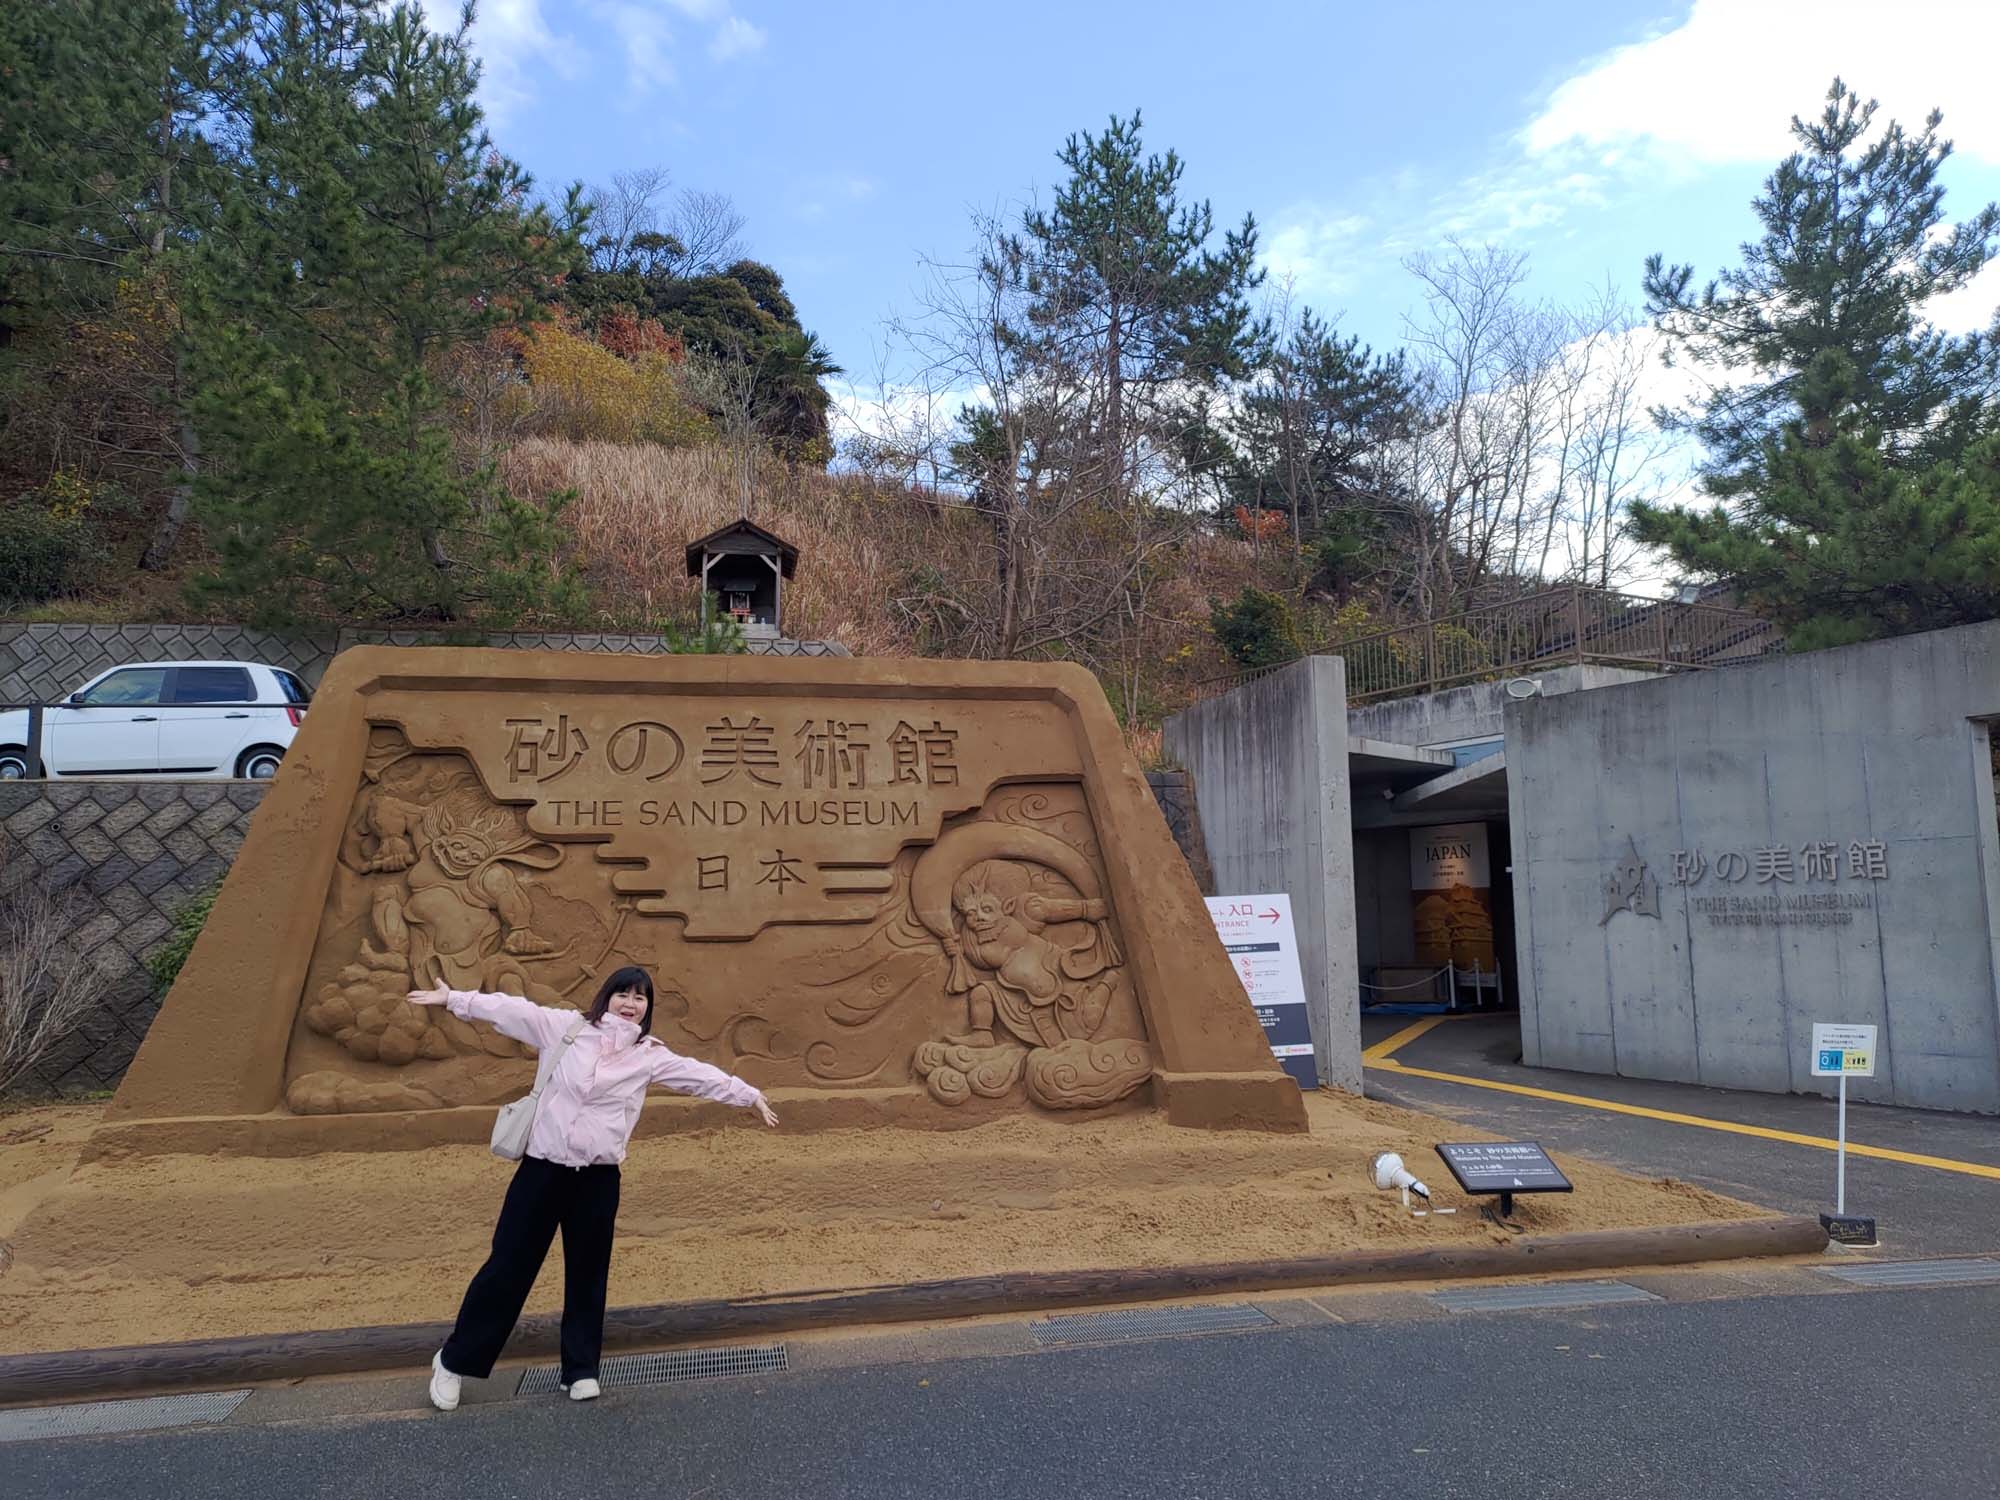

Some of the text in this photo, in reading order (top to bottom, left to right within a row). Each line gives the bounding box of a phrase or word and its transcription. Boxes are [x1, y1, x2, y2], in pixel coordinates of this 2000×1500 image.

[504, 714, 960, 790] 砂の美術館
[549, 800, 920, 826] THE SAND MUSEUM
[1425, 844, 1472, 863] JAPAN
[1670, 839, 1888, 885] 砂の美術館
[695, 848, 807, 895] 日本
[1228, 904, 1253, 917] 入口
[1692, 892, 1872, 912] THE SAND MUSEUM
[1215, 920, 1249, 929] NTRANCE
